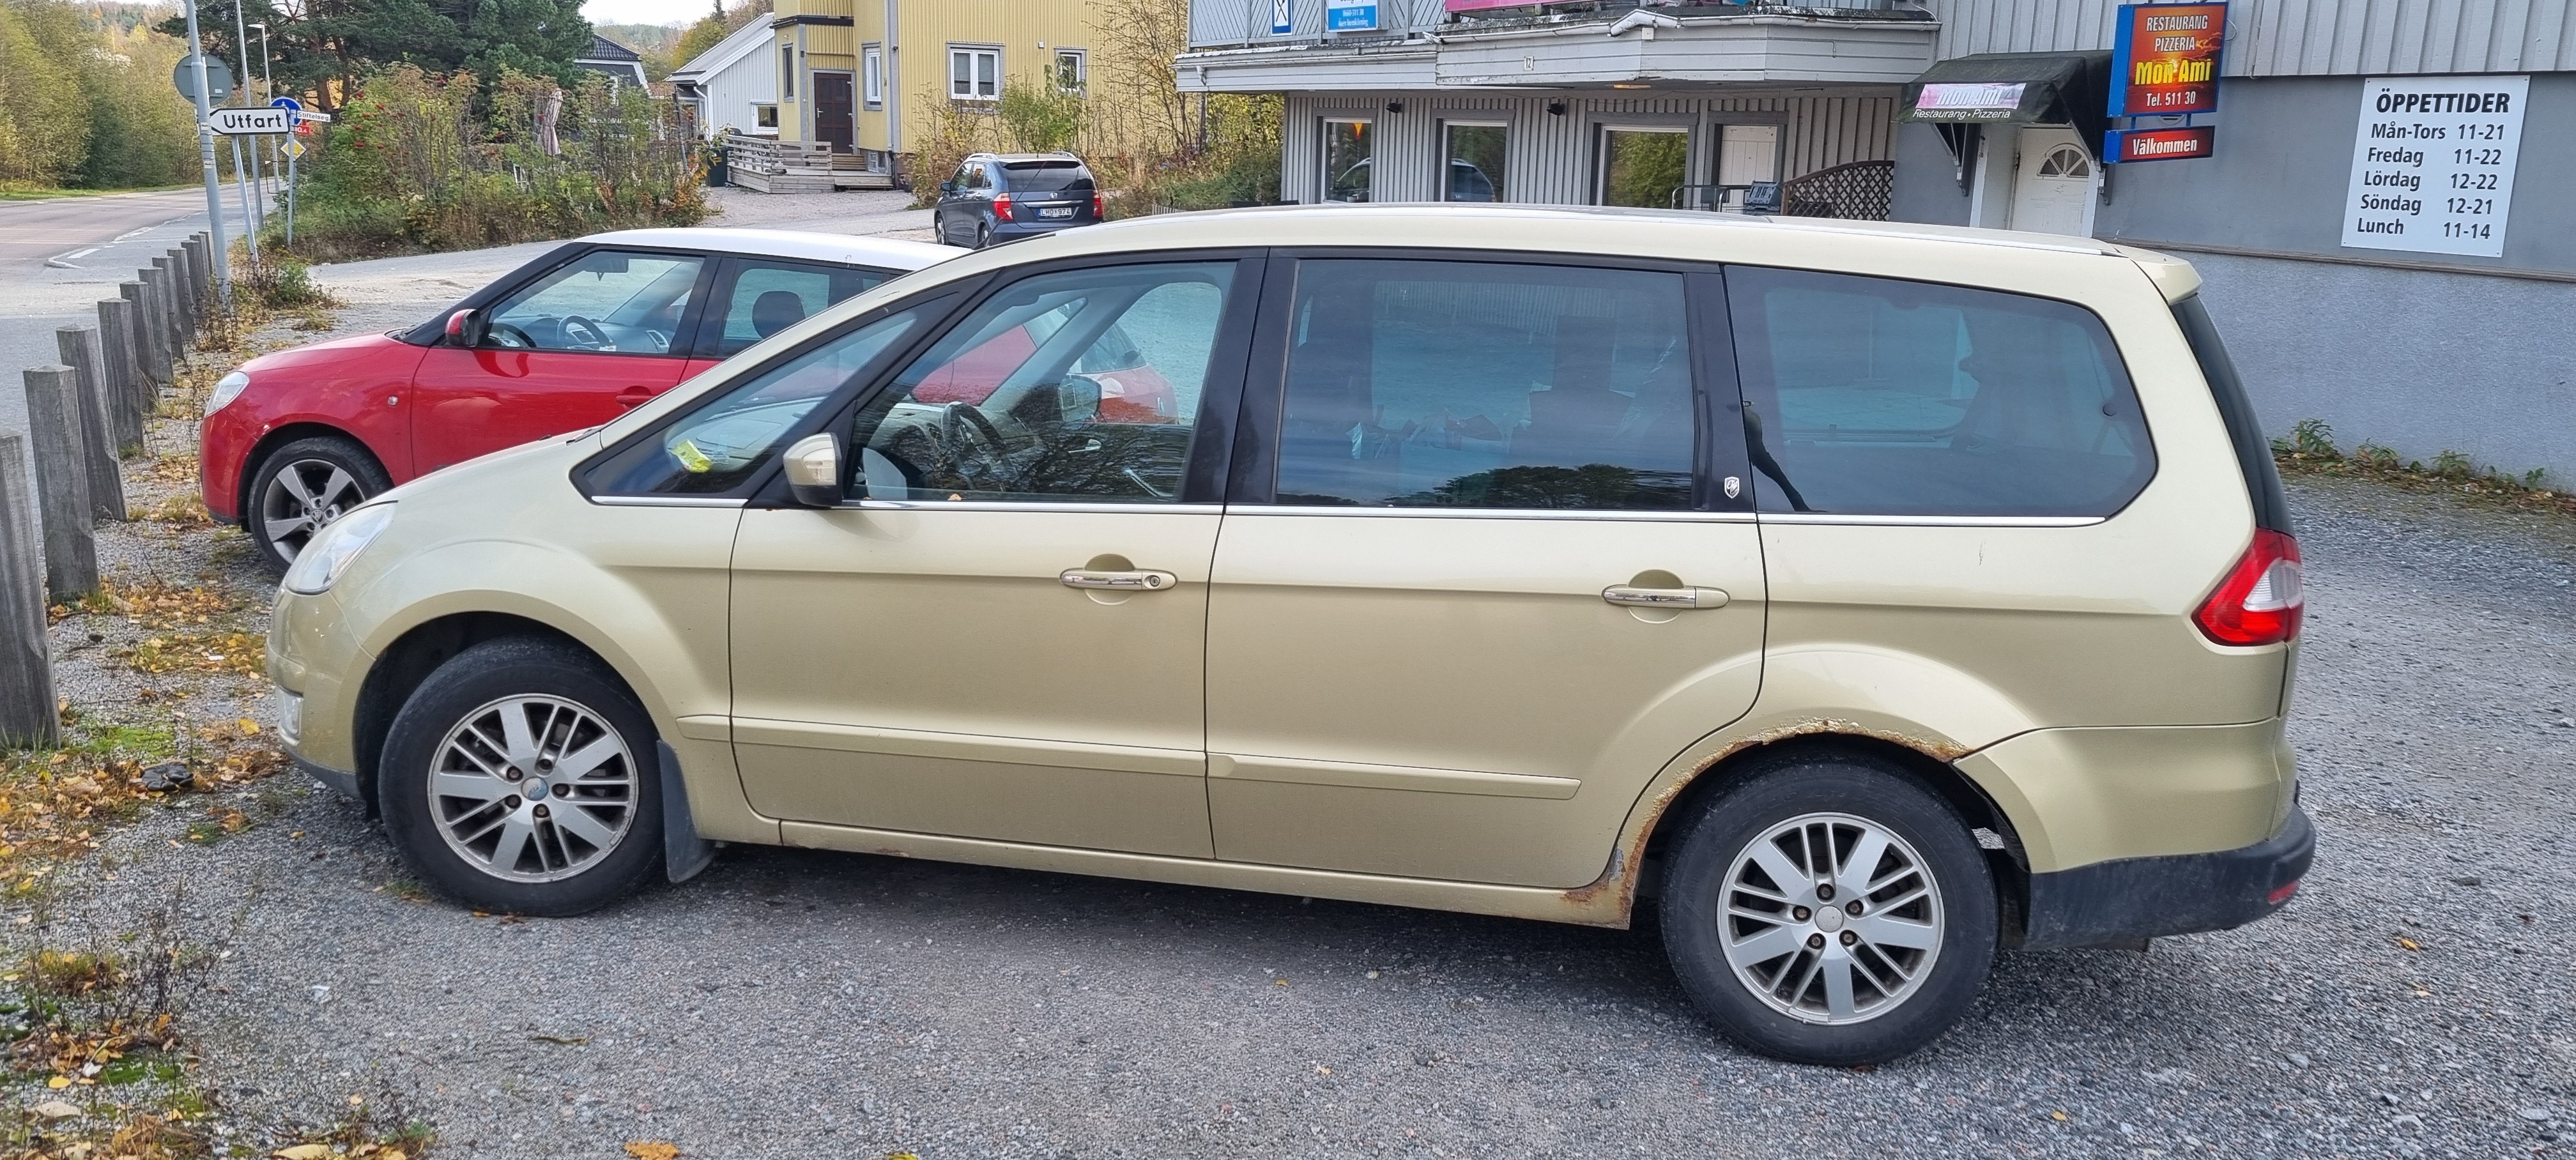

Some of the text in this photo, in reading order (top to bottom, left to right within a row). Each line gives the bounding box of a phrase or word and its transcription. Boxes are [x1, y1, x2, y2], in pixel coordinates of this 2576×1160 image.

[2146, 15, 2208, 31] RESTAURANG
[2154, 36, 2195, 52] PIZZERIA
[2135, 59, 2211, 85] Mon Ami
[1936, 87, 1972, 106] Mon
[2147, 91, 2196, 107] Tel. 511 30
[2376, 88, 2510, 113] ÖPPETTIDER
[223, 114, 282, 128] Utfart
[1912, 109, 2011, 120] Restaurang Pizzeria
[2371, 121, 2504, 140] Mån-Tors 11-21
[2133, 137, 2197, 155] Välkommen
[2368, 146, 2501, 167] Fredag 11-22
[2364, 170, 2498, 192] Lördag 12-22
[2360, 194, 2493, 216] Söndag 12-21
[2357, 218, 2490, 240] Lunch 11-14
